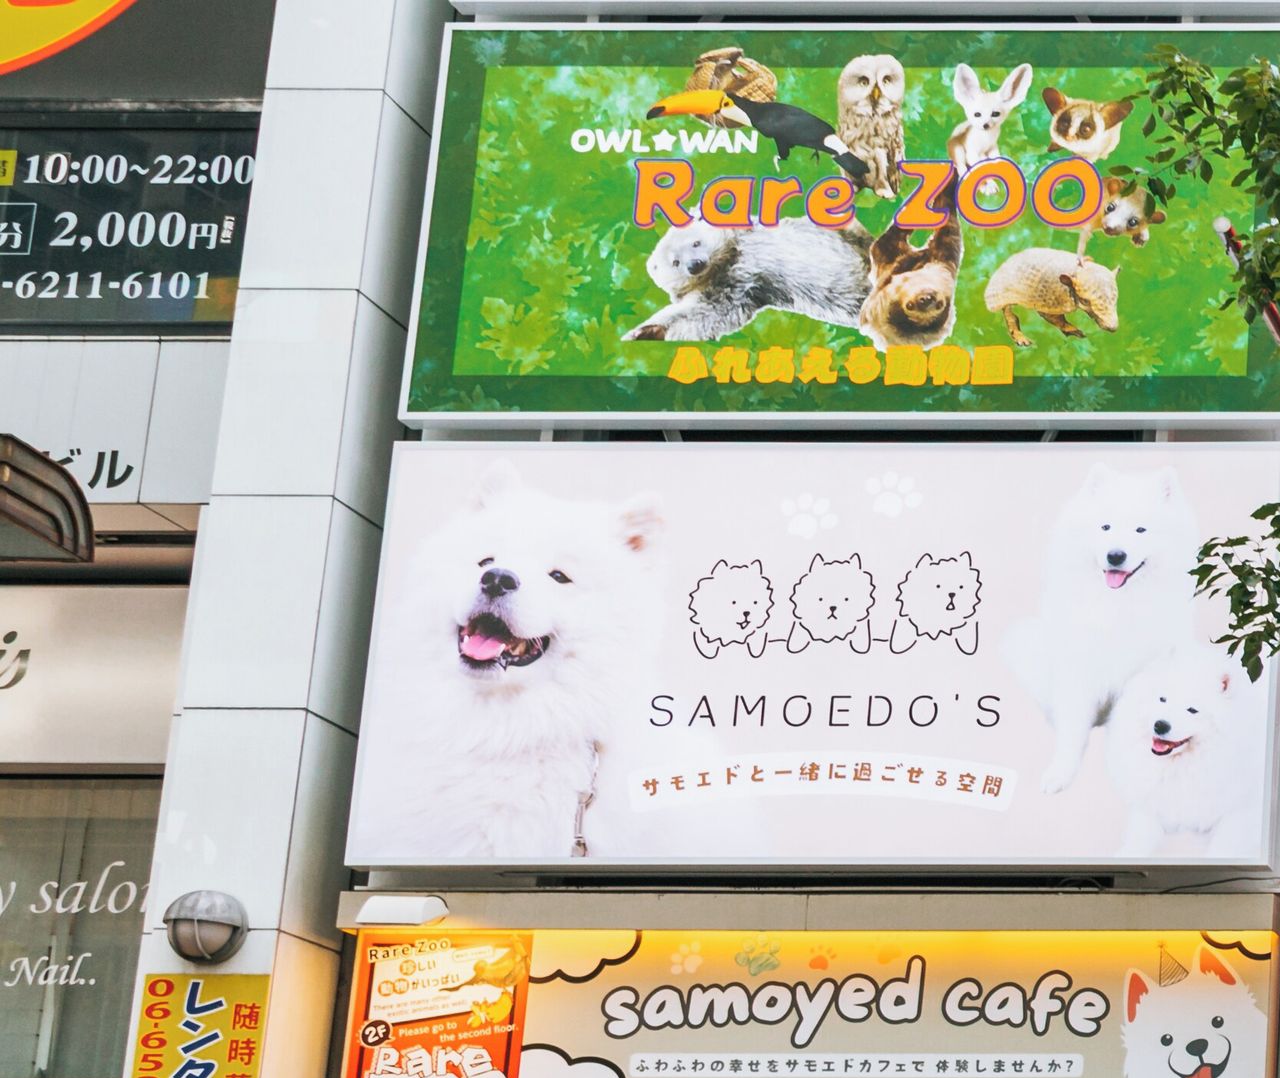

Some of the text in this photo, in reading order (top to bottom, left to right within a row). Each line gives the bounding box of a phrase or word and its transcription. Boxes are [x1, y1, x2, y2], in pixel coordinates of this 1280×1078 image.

[632, 157, 1105, 230] Rare ZOO
[649, 693, 1002, 727] SAMOEDO'S
[641, 761, 1004, 798] サモエドと一緒に過ごせる空間
[369, 944, 411, 961] Rare
[601, 954, 1110, 1048] samoyed cafe
[365, 1025, 387, 1043] 2F
[376, 1045, 492, 1077] Rare
